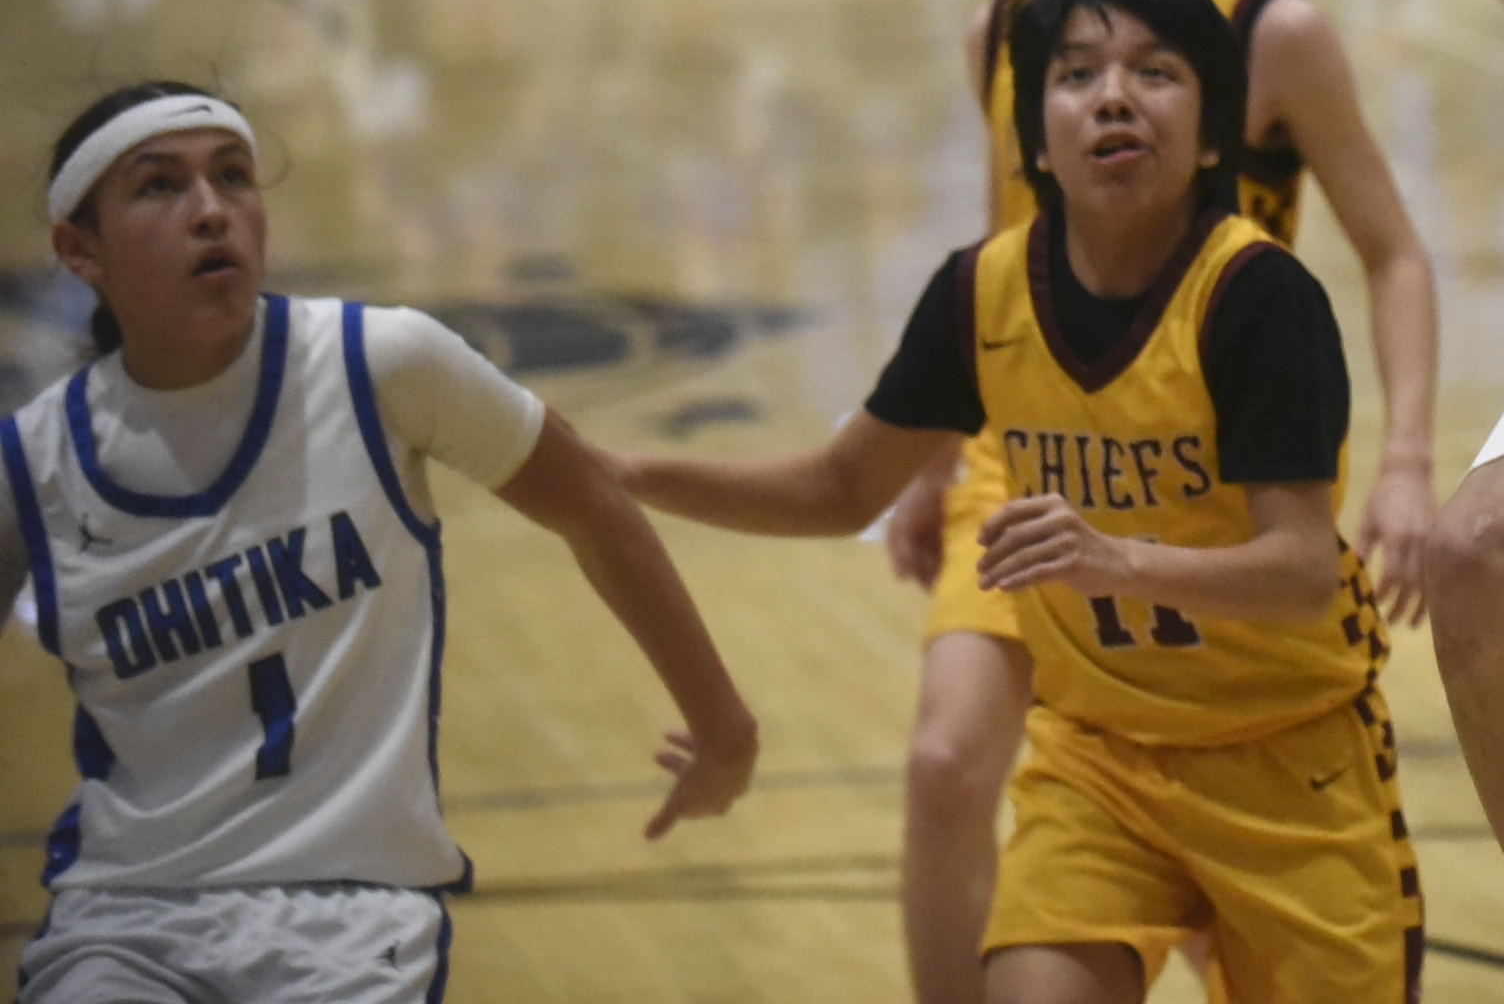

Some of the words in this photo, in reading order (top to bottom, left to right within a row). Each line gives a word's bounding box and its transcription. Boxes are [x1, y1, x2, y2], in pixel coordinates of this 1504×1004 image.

[1003, 428, 1211, 510] CHIEFS
[96, 511, 381, 680] OHITIKA
[248, 652, 298, 781] 1
